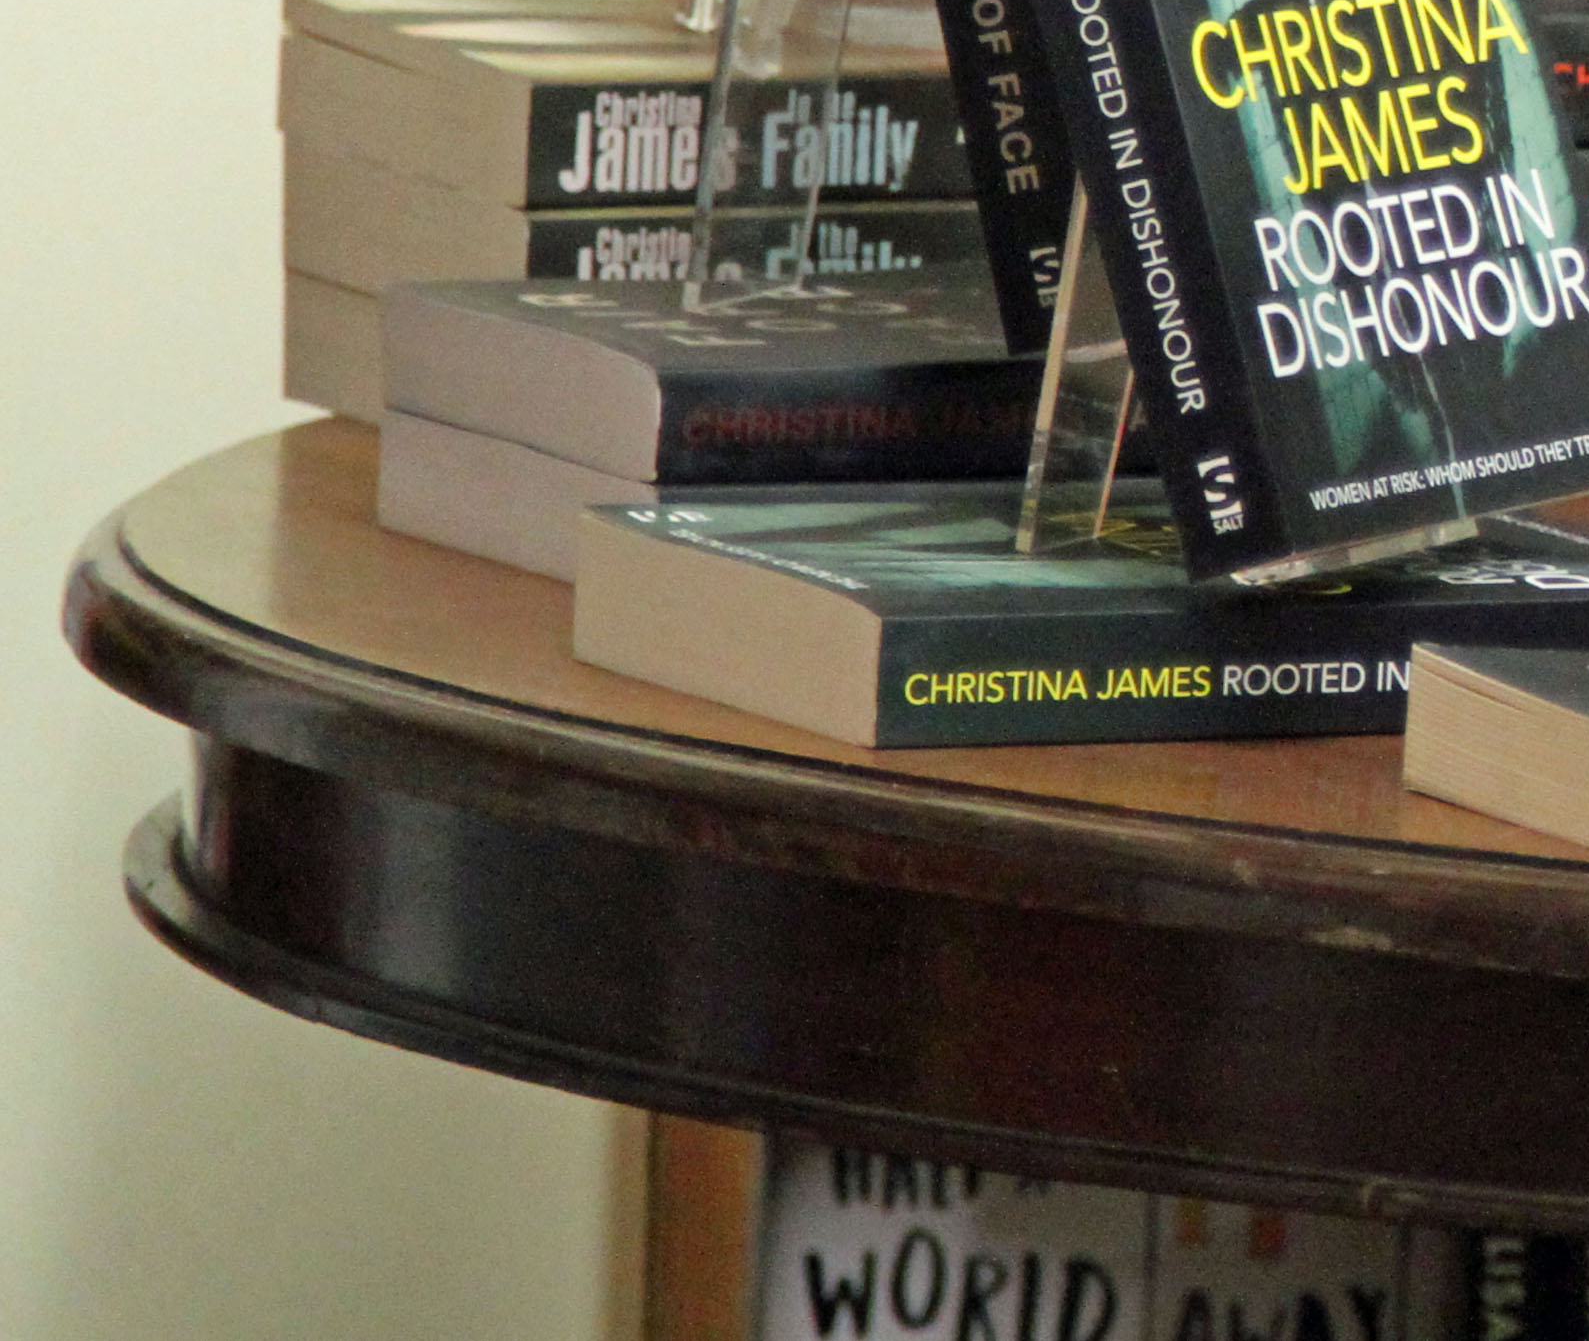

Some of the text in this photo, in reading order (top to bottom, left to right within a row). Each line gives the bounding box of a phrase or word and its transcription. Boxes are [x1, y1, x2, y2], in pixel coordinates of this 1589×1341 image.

[558, 110, 740, 193] James
[987, 72, 1041, 196] FACE
[1107, 126, 1144, 172] IN
[1281, 76, 1485, 196] JAMES
[1253, 167, 1556, 294] ROOTED IN
[1122, 176, 1208, 416] DISHONOUR
[1309, 481, 1373, 512] WOMEN
[1372, 478, 1392, 499] AT
[1391, 470, 1425, 496] RISK:
[1425, 462, 1475, 489] WHOM
[1475, 450, 1536, 481] SHOULD
[1535, 439, 1575, 467] THEY
[903, 661, 1410, 707] CHRISTINA JAMES ROOTED IN
